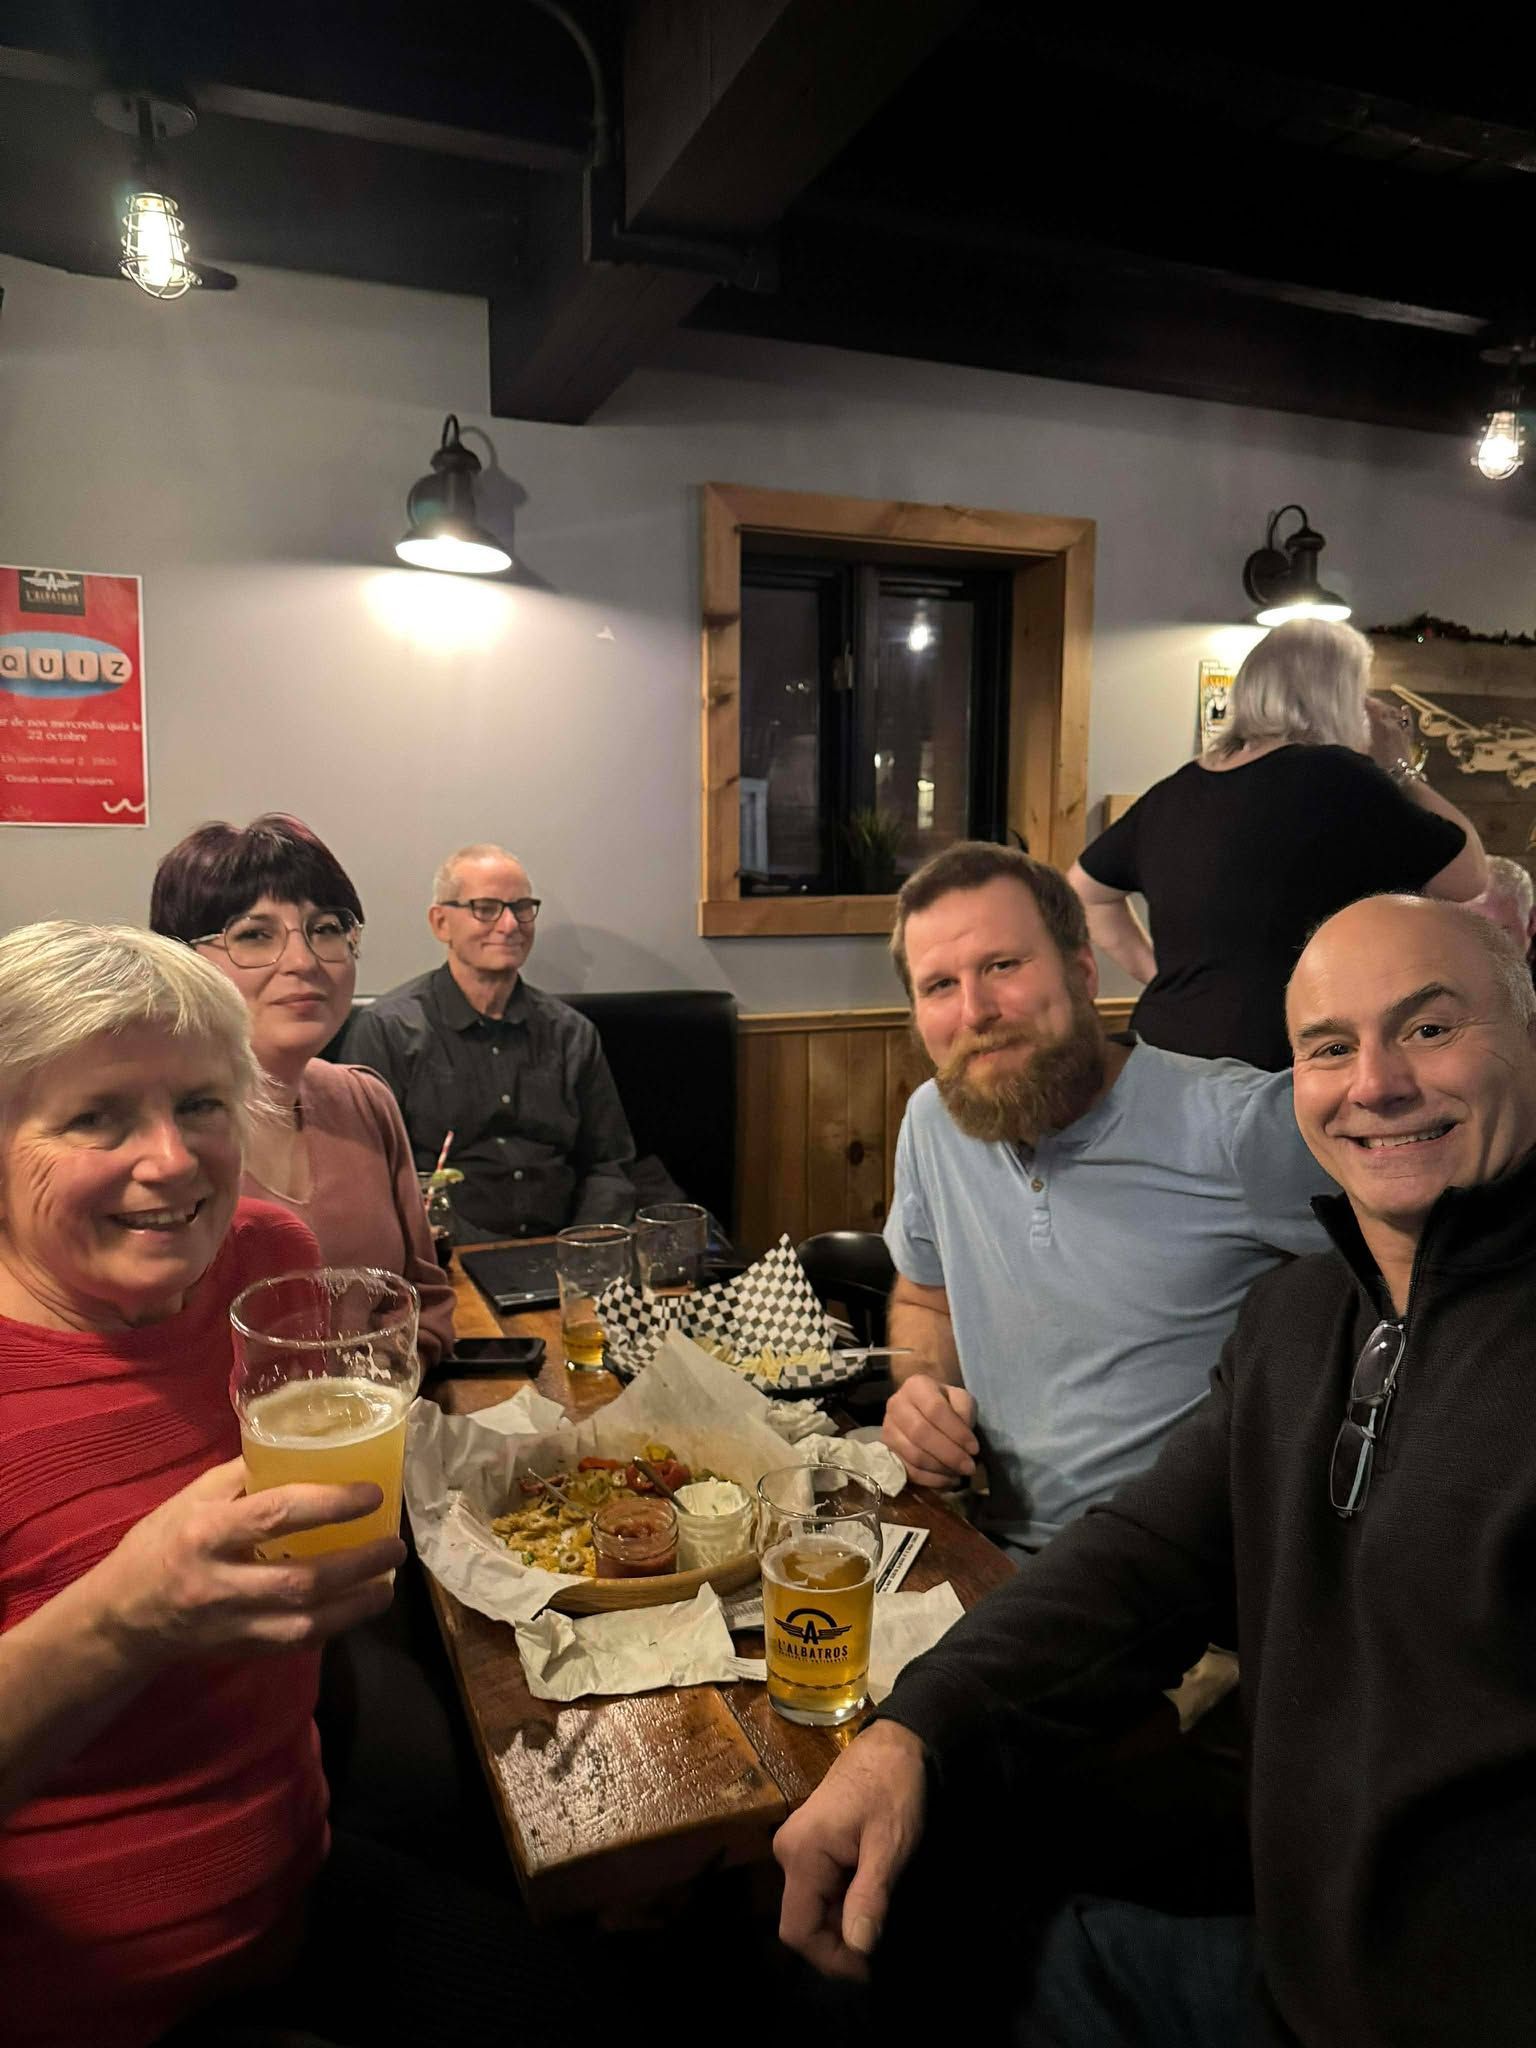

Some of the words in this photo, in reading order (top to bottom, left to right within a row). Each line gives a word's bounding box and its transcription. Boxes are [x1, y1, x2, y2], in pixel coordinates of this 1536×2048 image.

[2, 655, 125, 677] QUIZ
[10, 715, 25, 727] de
[46, 731, 88, 742] octobre
[777, 1638, 849, 1660] L'ALBATROS
